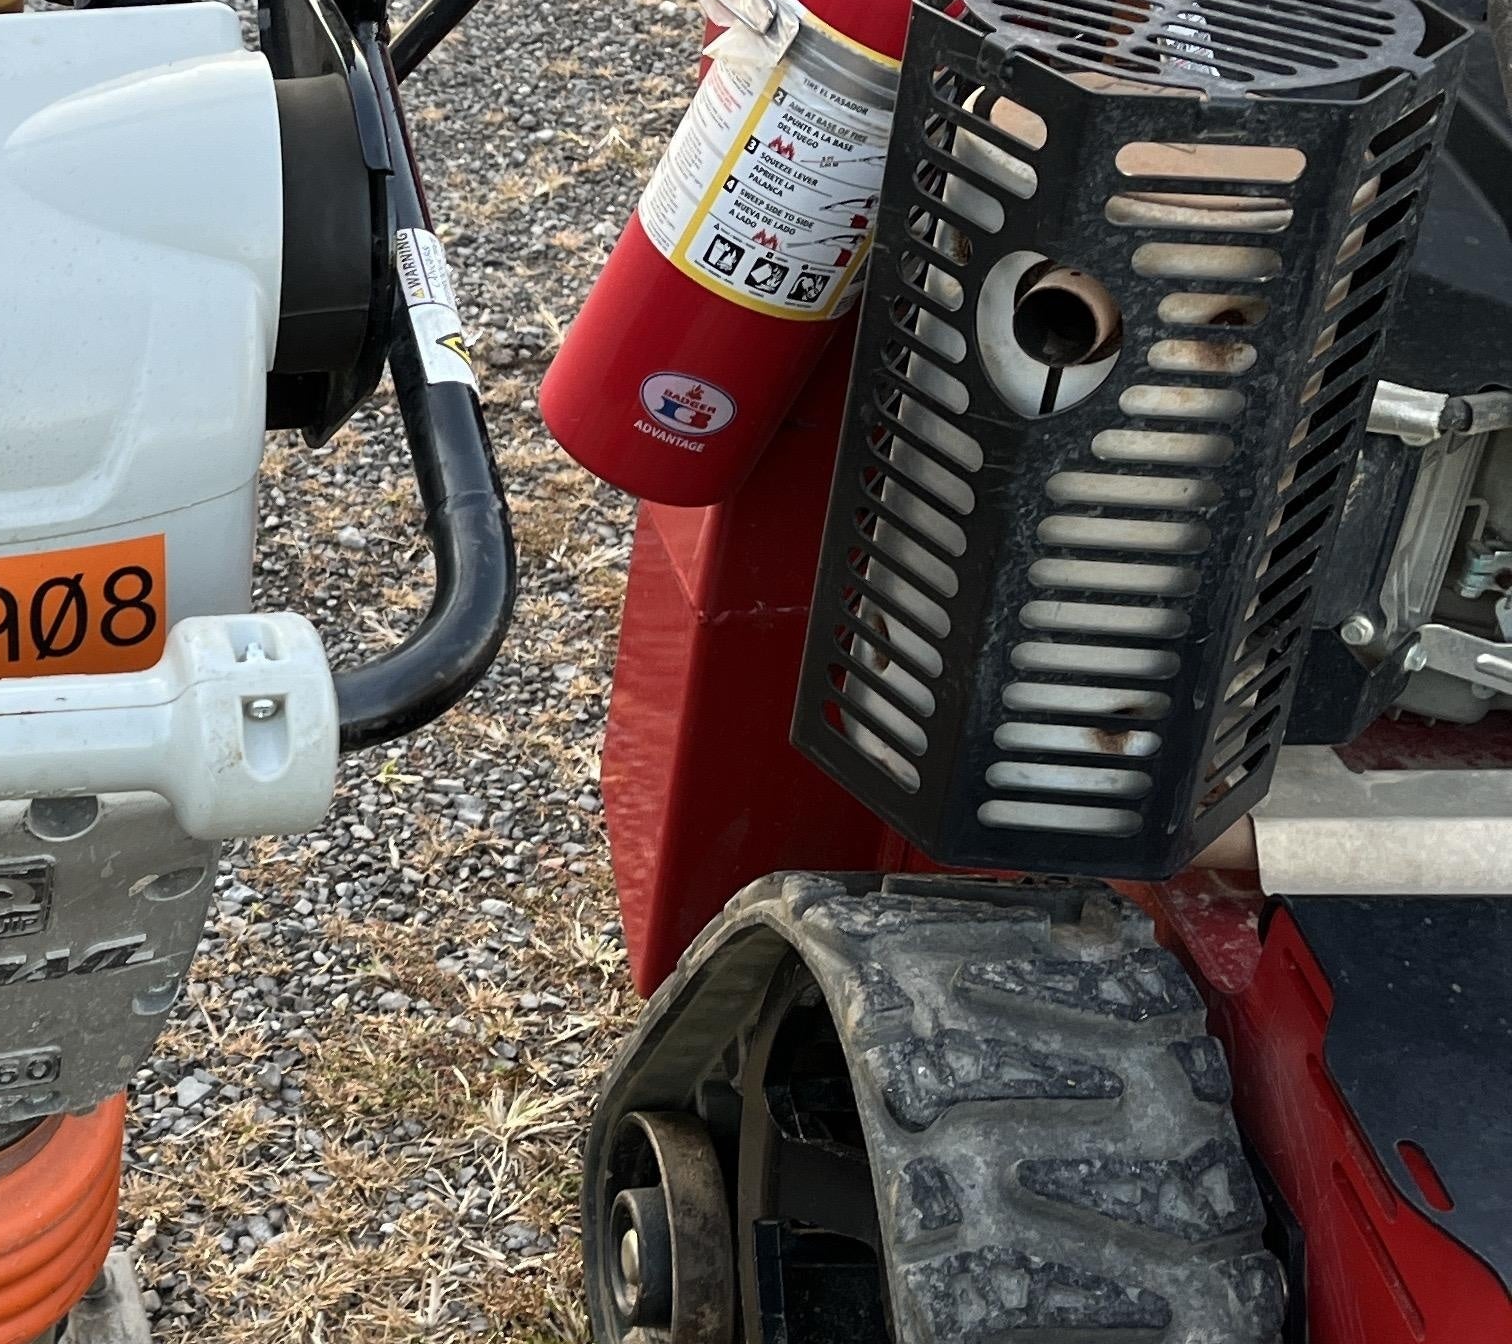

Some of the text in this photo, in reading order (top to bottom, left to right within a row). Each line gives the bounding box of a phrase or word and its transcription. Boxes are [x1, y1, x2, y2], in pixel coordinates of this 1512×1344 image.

[774, 91, 784, 101] 2
[829, 92, 869, 116] PASADOR
[777, 121, 820, 150] DEL FUEGO
[781, 112, 855, 153] APUNTE A LA BASE
[788, 101, 869, 143] AIM AT BASE OF FIRE
[748, 140, 757, 151] 3
[752, 164, 795, 192] APRIETE LA
[759, 151, 819, 187] SQUEEZE LEVER
[726, 178, 736, 190] 4
[748, 172, 784, 197] PALANCA
[728, 208, 758, 229] A LADO
[733, 199, 796, 236] MUEVA DE LADO
[739, 188, 815, 230] SWEEP SIDE TO SIDE
[396, 232, 421, 290] WARNING
[662, 388, 717, 415] BADGER
[633, 419, 706, 453] ADVANTAGE
